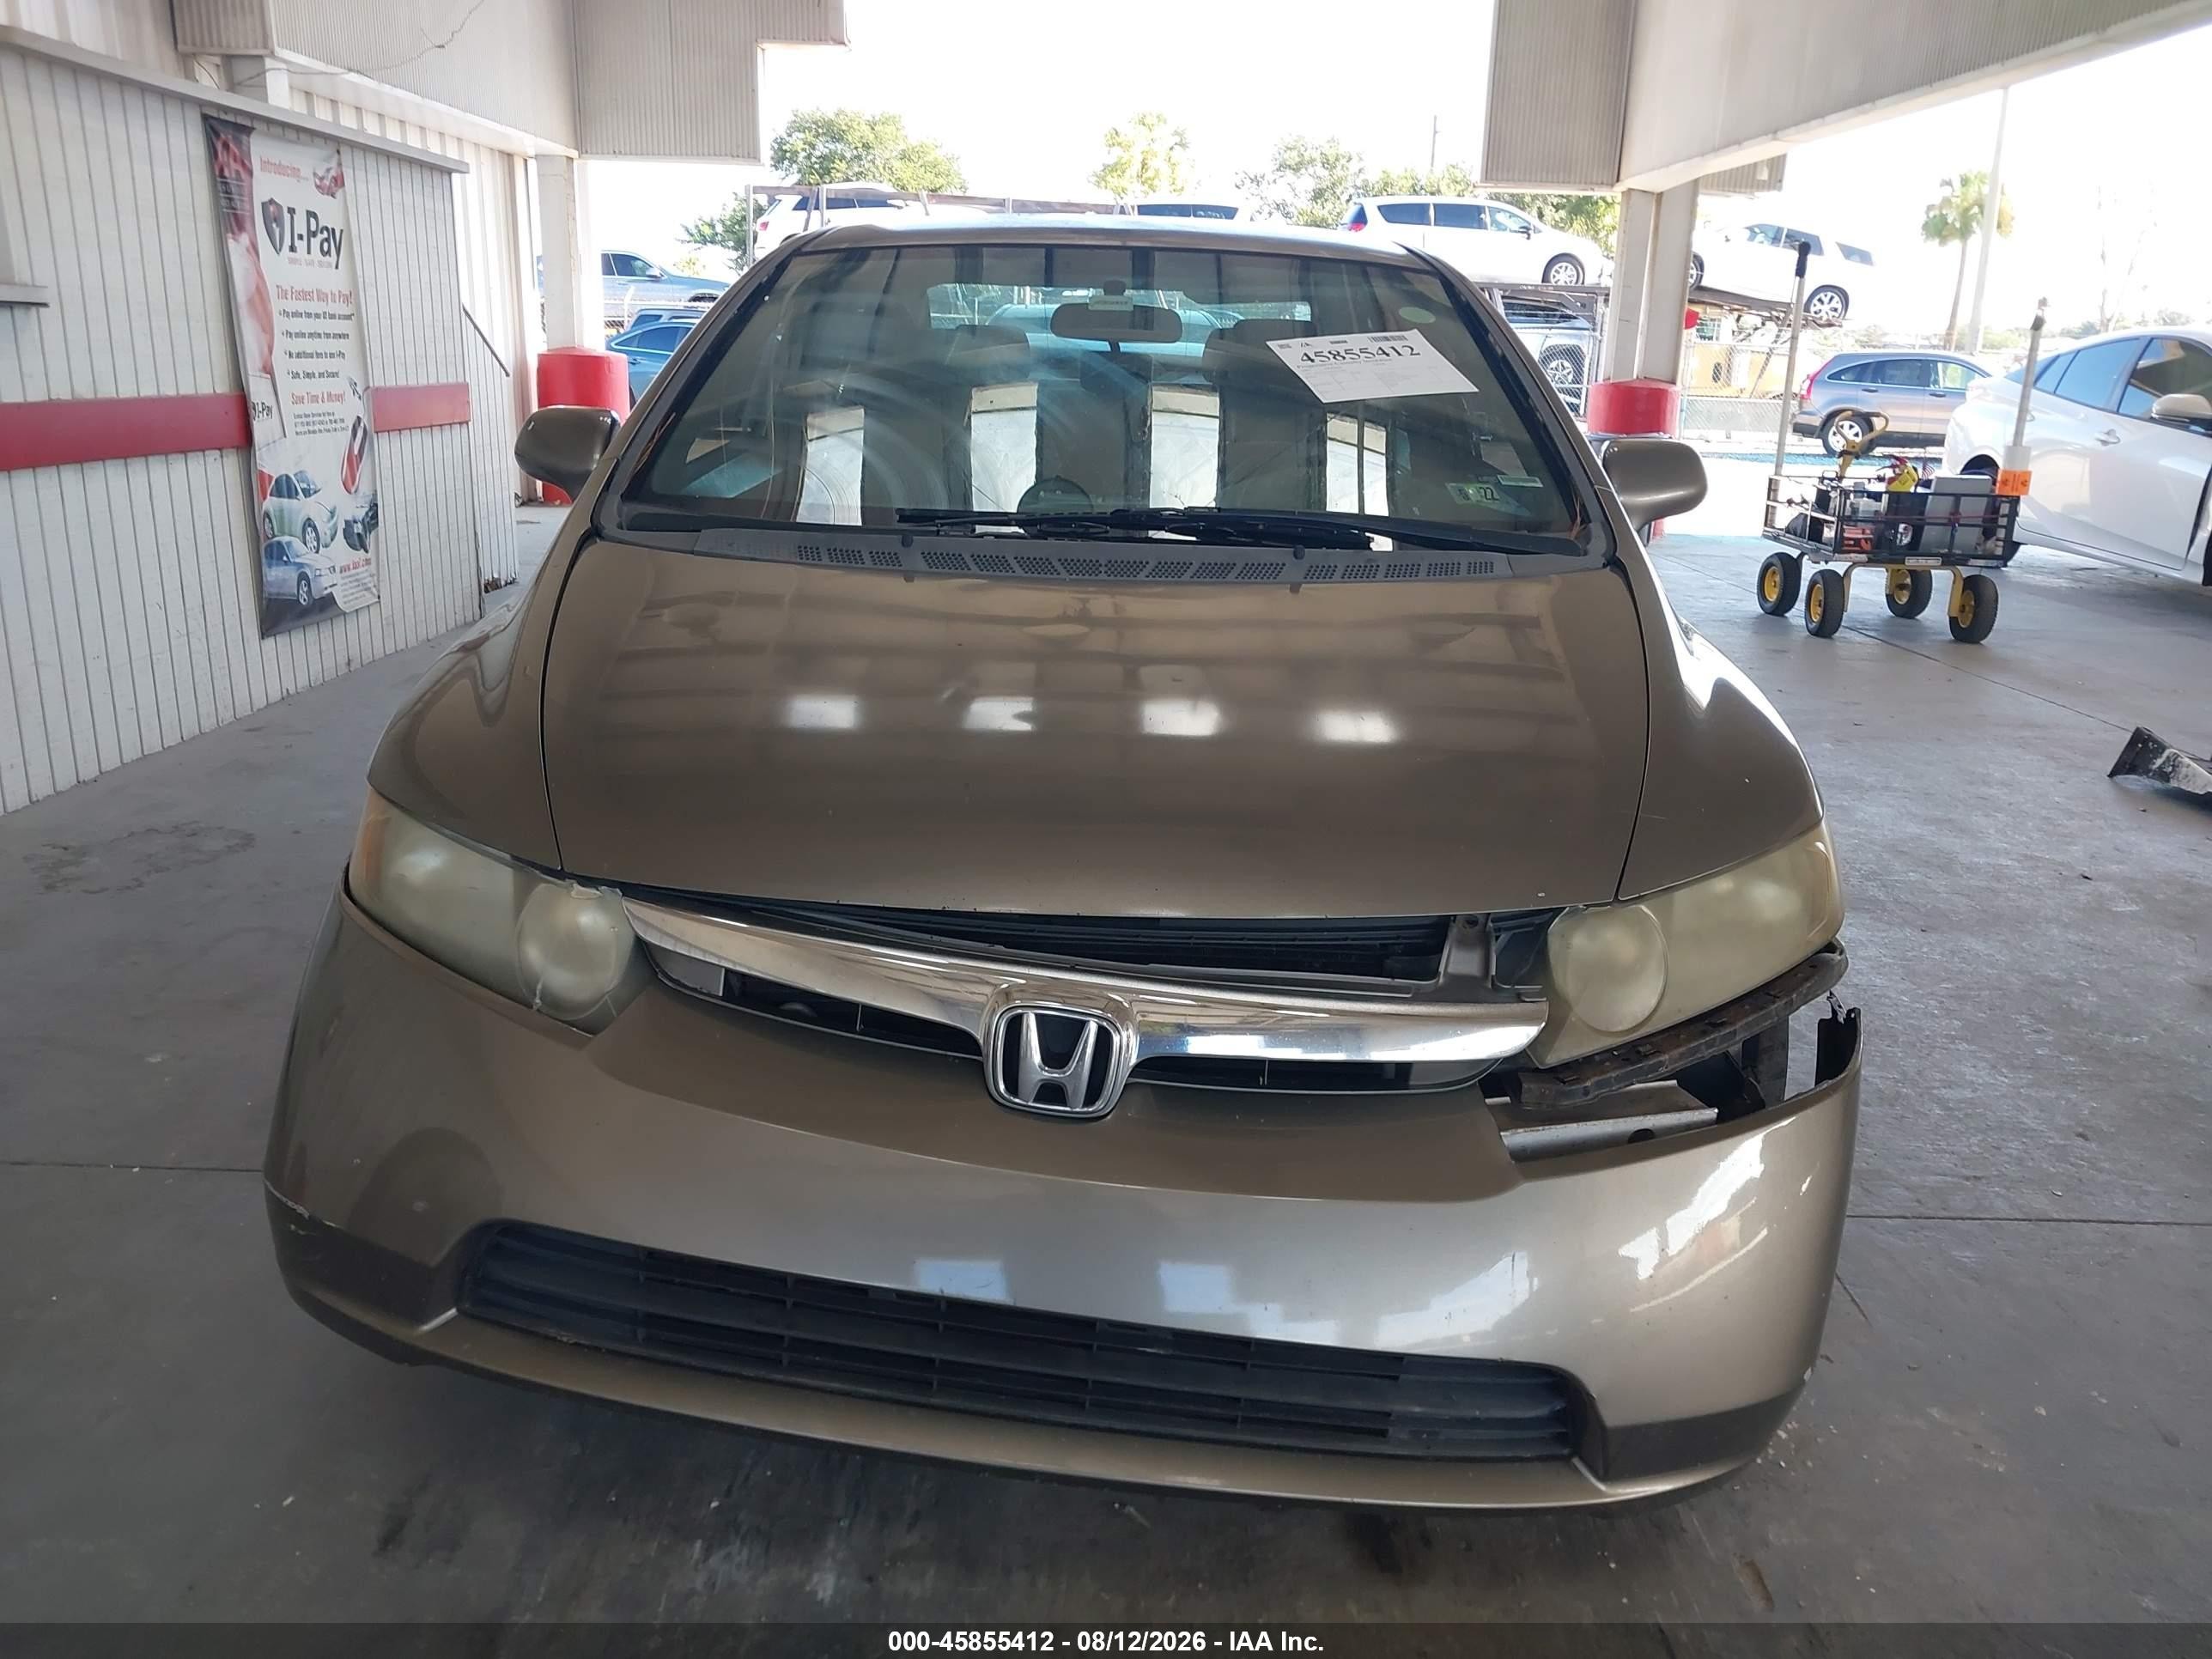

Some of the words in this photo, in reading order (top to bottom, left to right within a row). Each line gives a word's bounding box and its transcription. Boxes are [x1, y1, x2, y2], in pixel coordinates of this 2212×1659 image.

[287, 206, 343, 270] I-Pay
[276, 285, 289, 301] The
[291, 285, 315, 302] Fastest
[315, 289, 329, 306] Way
[338, 289, 352, 307] Pay!
[1300, 344, 1421, 364] 45855412
[290, 392, 305, 405] Save
[307, 392, 319, 404] Time
[321, 392, 325, 404] &
[257, 401, 272, 420] I-Pay
